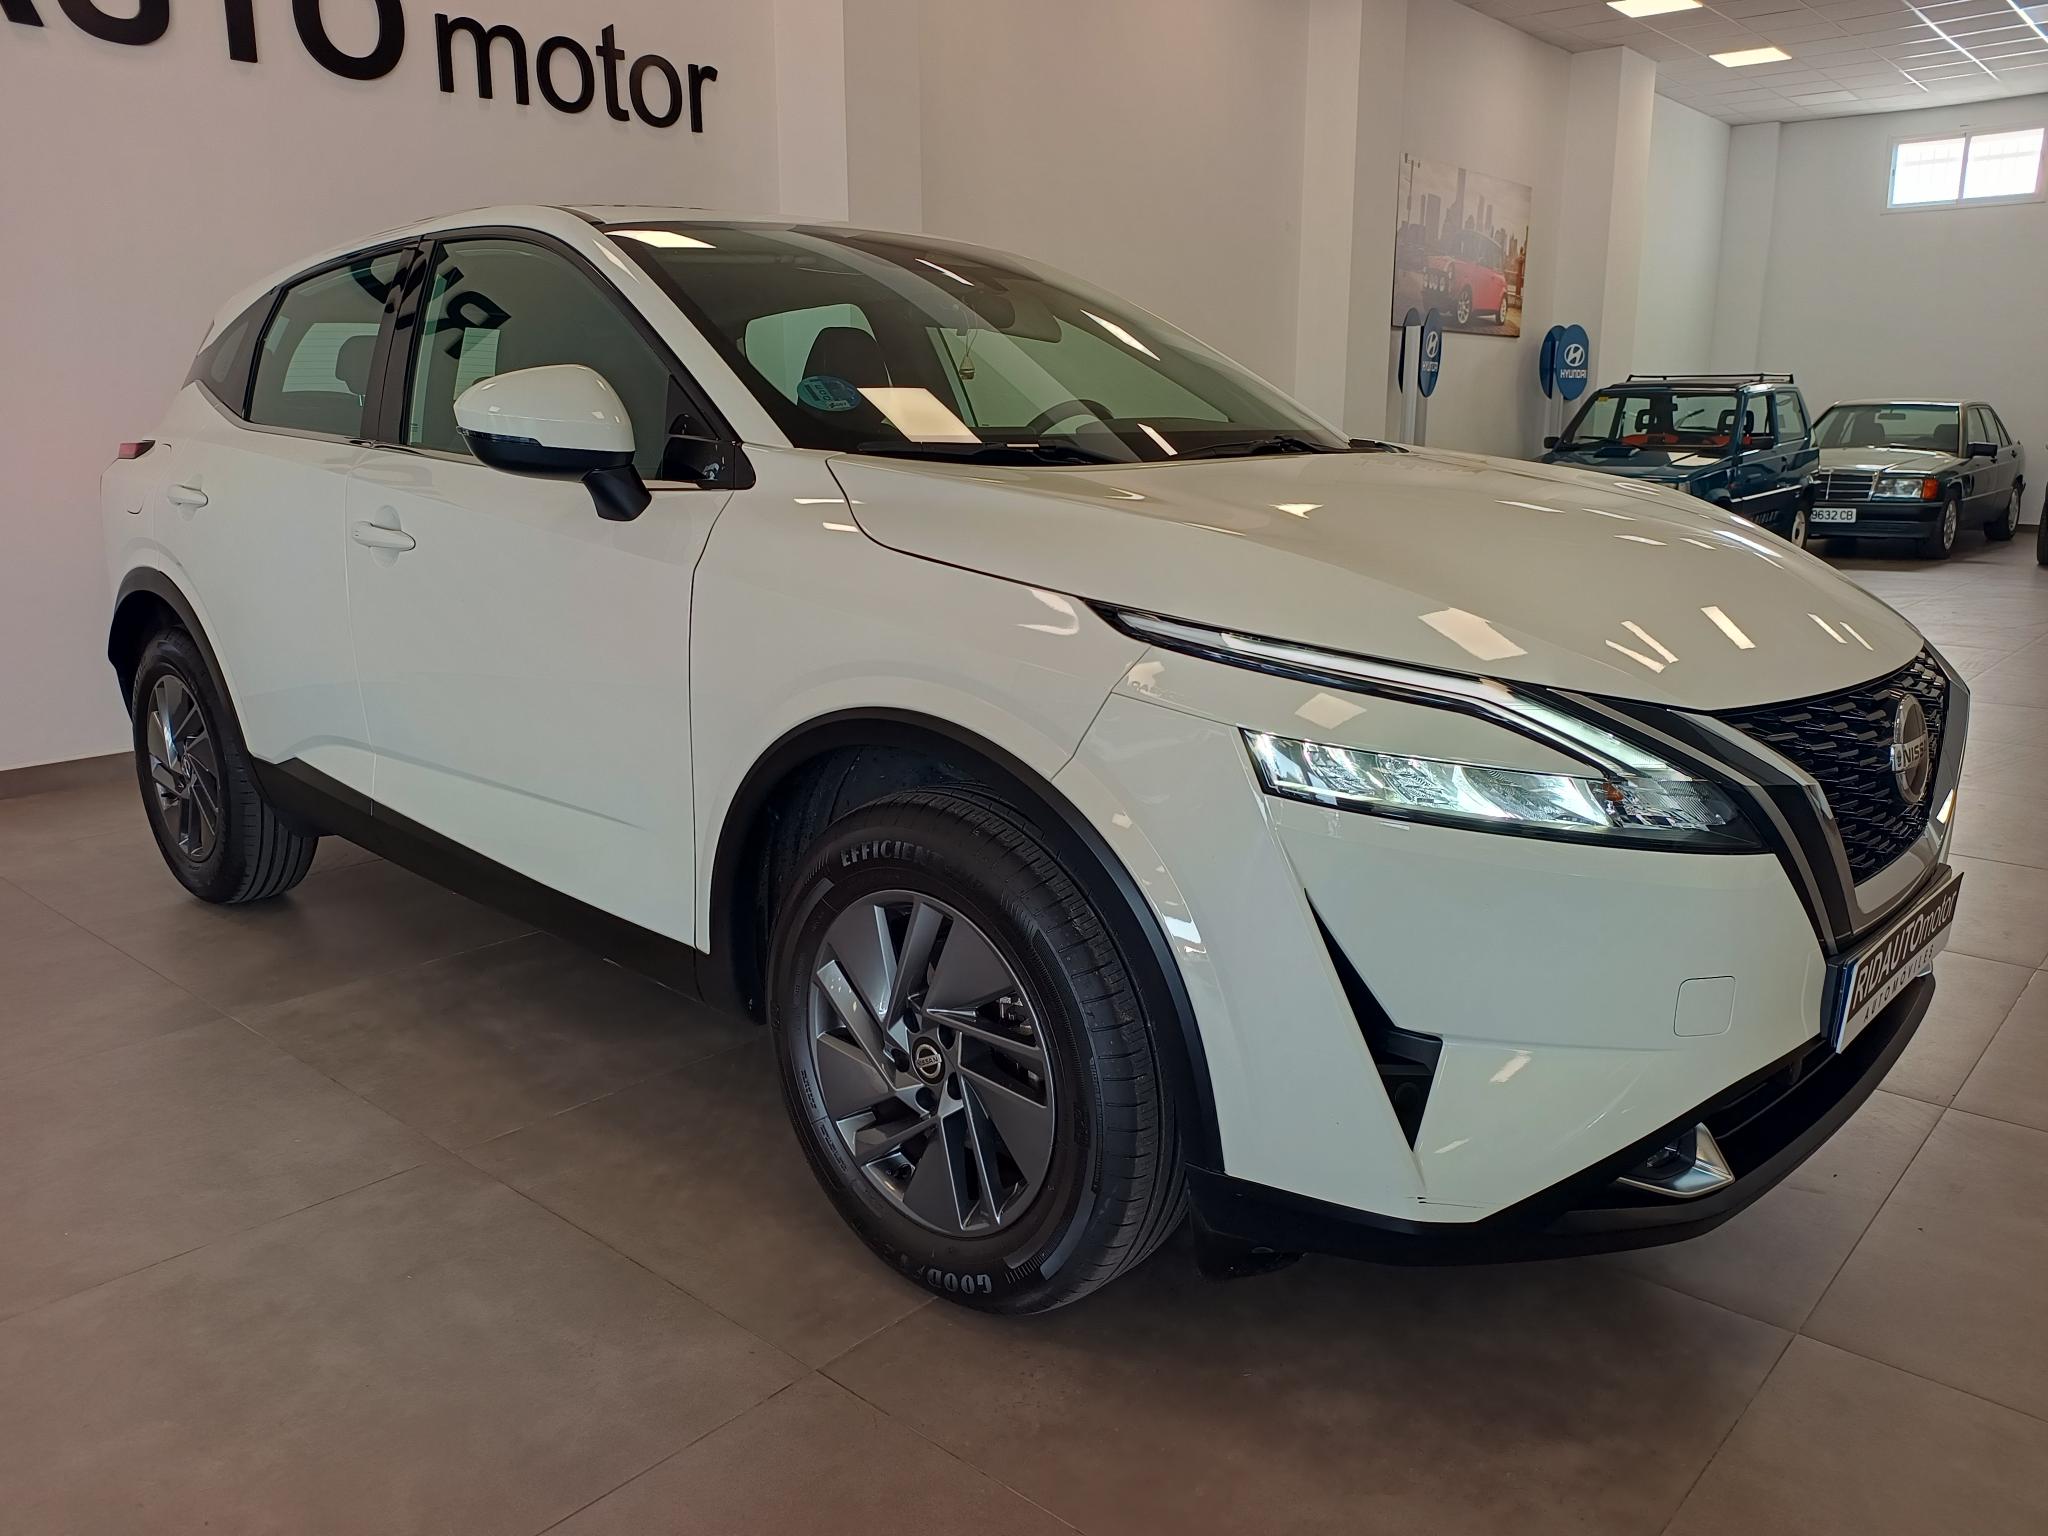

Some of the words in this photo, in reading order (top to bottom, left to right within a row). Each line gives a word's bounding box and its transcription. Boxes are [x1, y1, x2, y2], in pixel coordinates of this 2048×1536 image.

[434, 13, 718, 134] motor
[1559, 368, 1588, 380] HYUNDAI
[1811, 509, 1838, 521] 9632
[1839, 509, 1854, 521] CB
[1903, 739, 1926, 766] NISS
